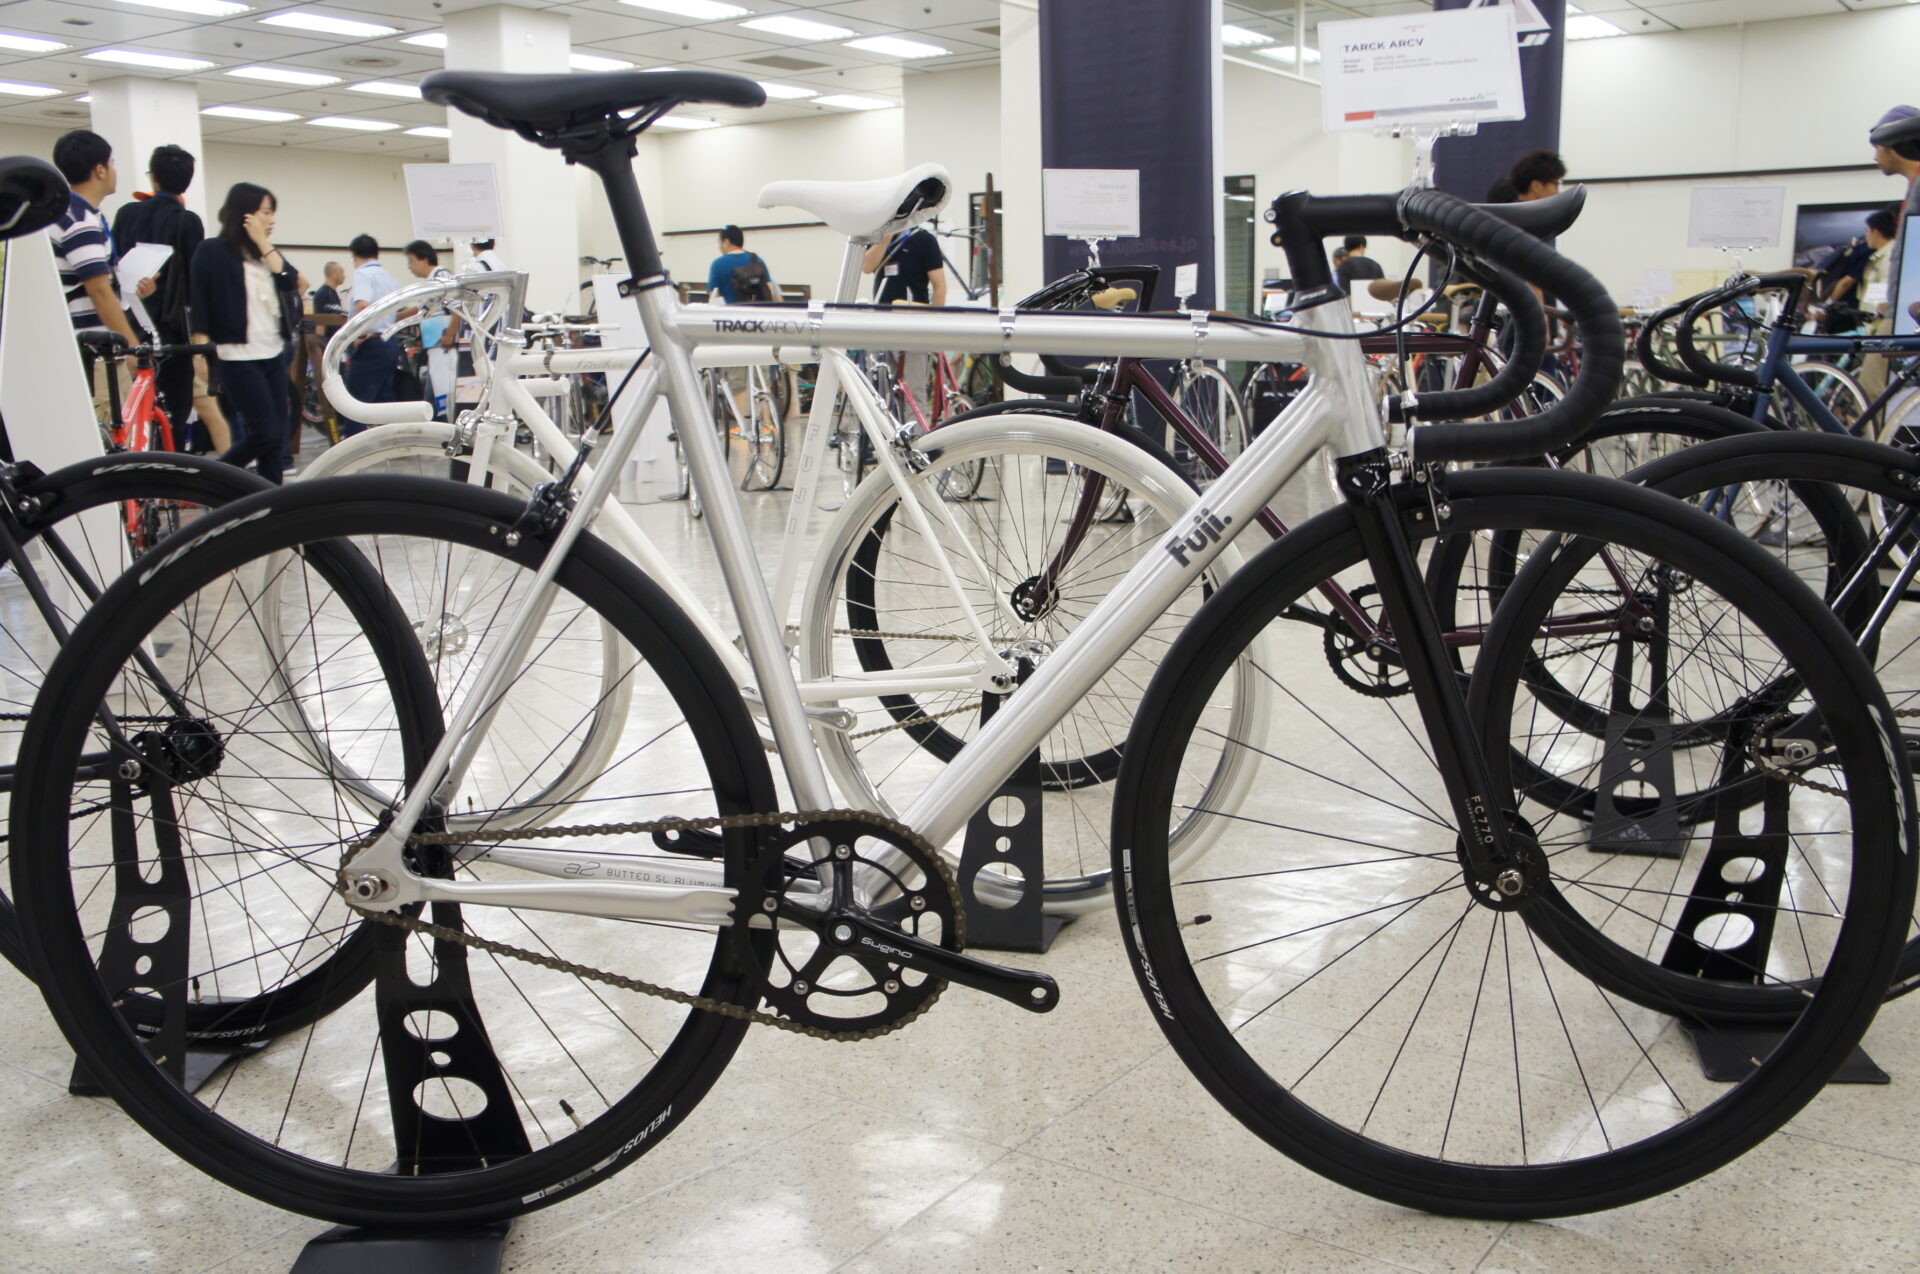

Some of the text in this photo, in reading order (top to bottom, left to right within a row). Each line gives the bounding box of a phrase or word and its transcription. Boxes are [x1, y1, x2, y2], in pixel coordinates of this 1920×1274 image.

[1343, 38, 1424, 54] TARCK ARCV
[788, 423, 821, 534] FUJI
[1470, 795, 1494, 844] FC770
[606, 868, 650, 882] BUTTED
[655, 874, 669, 884] SL
[1141, 958, 1175, 1021] HELIOS
[623, 1104, 673, 1154] HELIOS
